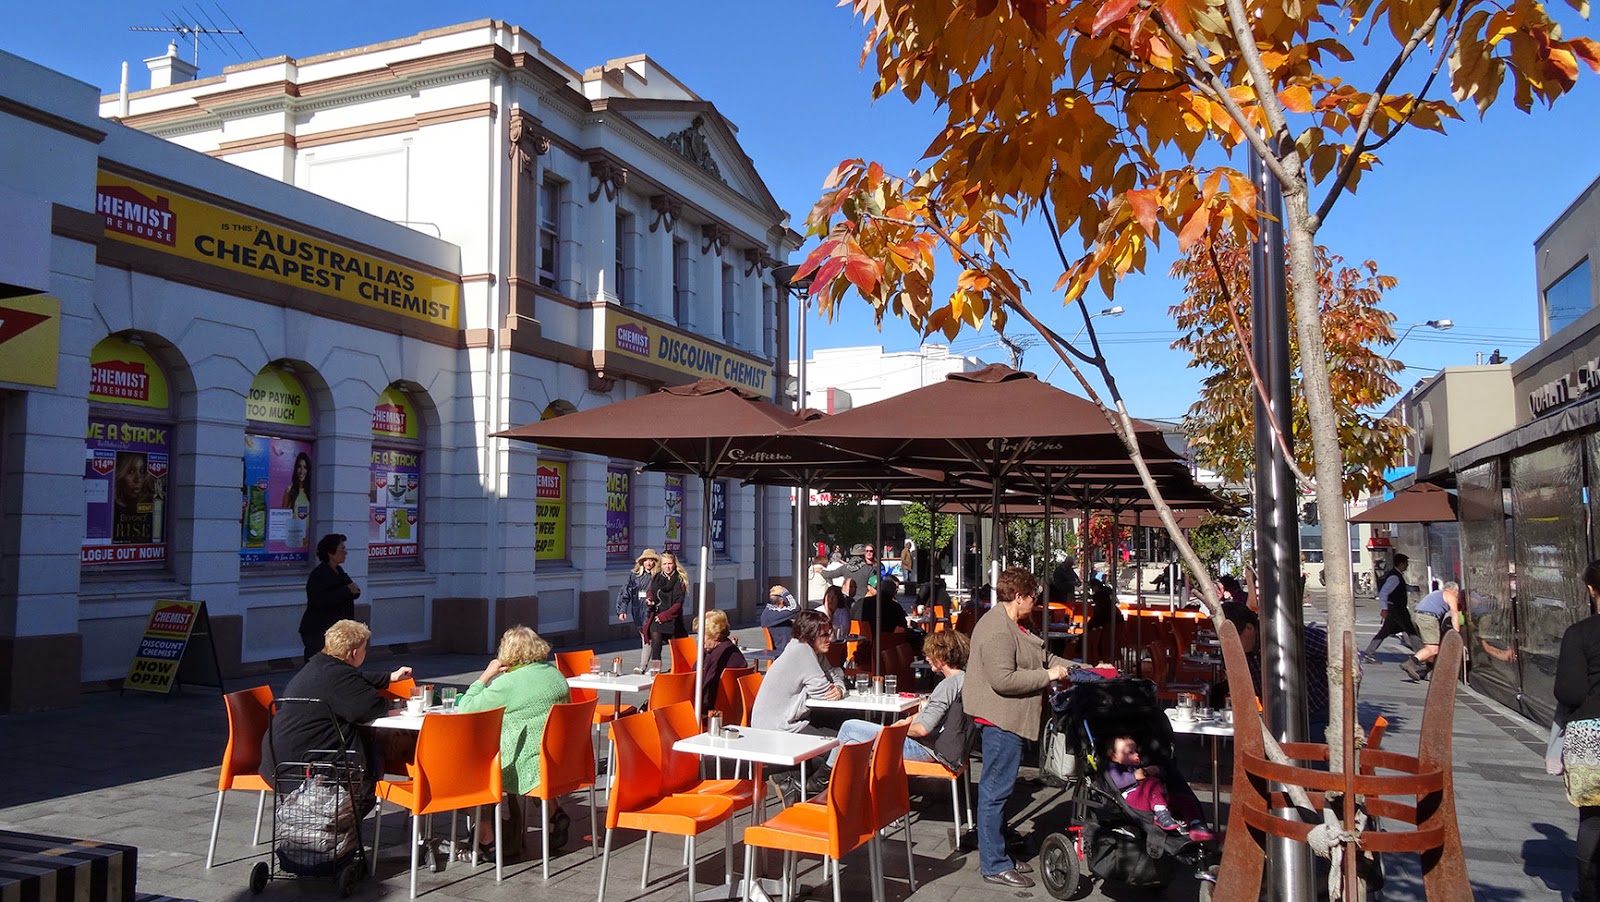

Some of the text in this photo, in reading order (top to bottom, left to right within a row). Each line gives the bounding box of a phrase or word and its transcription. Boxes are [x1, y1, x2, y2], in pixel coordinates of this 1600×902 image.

[97, 193, 172, 230] HEMIST
[106, 217, 171, 242] REHOUSE
[221, 223, 230, 231] IS
[232, 224, 252, 232] THIS
[253, 227, 415, 291] AUSTRALIA'S
[194, 234, 450, 321] CHEAPEST CHEMIST
[617, 327, 649, 348] CHEMIST
[658, 335, 767, 390] DISCOUNT CHEMIST
[91, 367, 146, 389] CHEMIST
[249, 388, 301, 406] TOP PAYING
[248, 404, 295, 420] TOO MUCH
[86, 422, 105, 439] VE
[107, 423, 118, 440] A
[371, 451, 380, 464] VE
[382, 451, 389, 465] A
[537, 475, 559, 489] EMIST
[606, 472, 629, 492] AVE A
[606, 492, 627, 512] TACK
[550, 505, 560, 518] YOU
[115, 524, 151, 538] RISE
[539, 522, 556, 535] WERE
[712, 520, 723, 539] FF
[81, 546, 165, 561] LOGUE OUT NOW!
[368, 545, 417, 557] LOGUE OUT NOW!
[154, 611, 191, 624] CHEMIST
[142, 639, 184, 650] DISCOUNT
[142, 648, 178, 657] CHEMIST
[135, 660, 173, 674] NOW
[130, 672, 170, 686] OPEN
